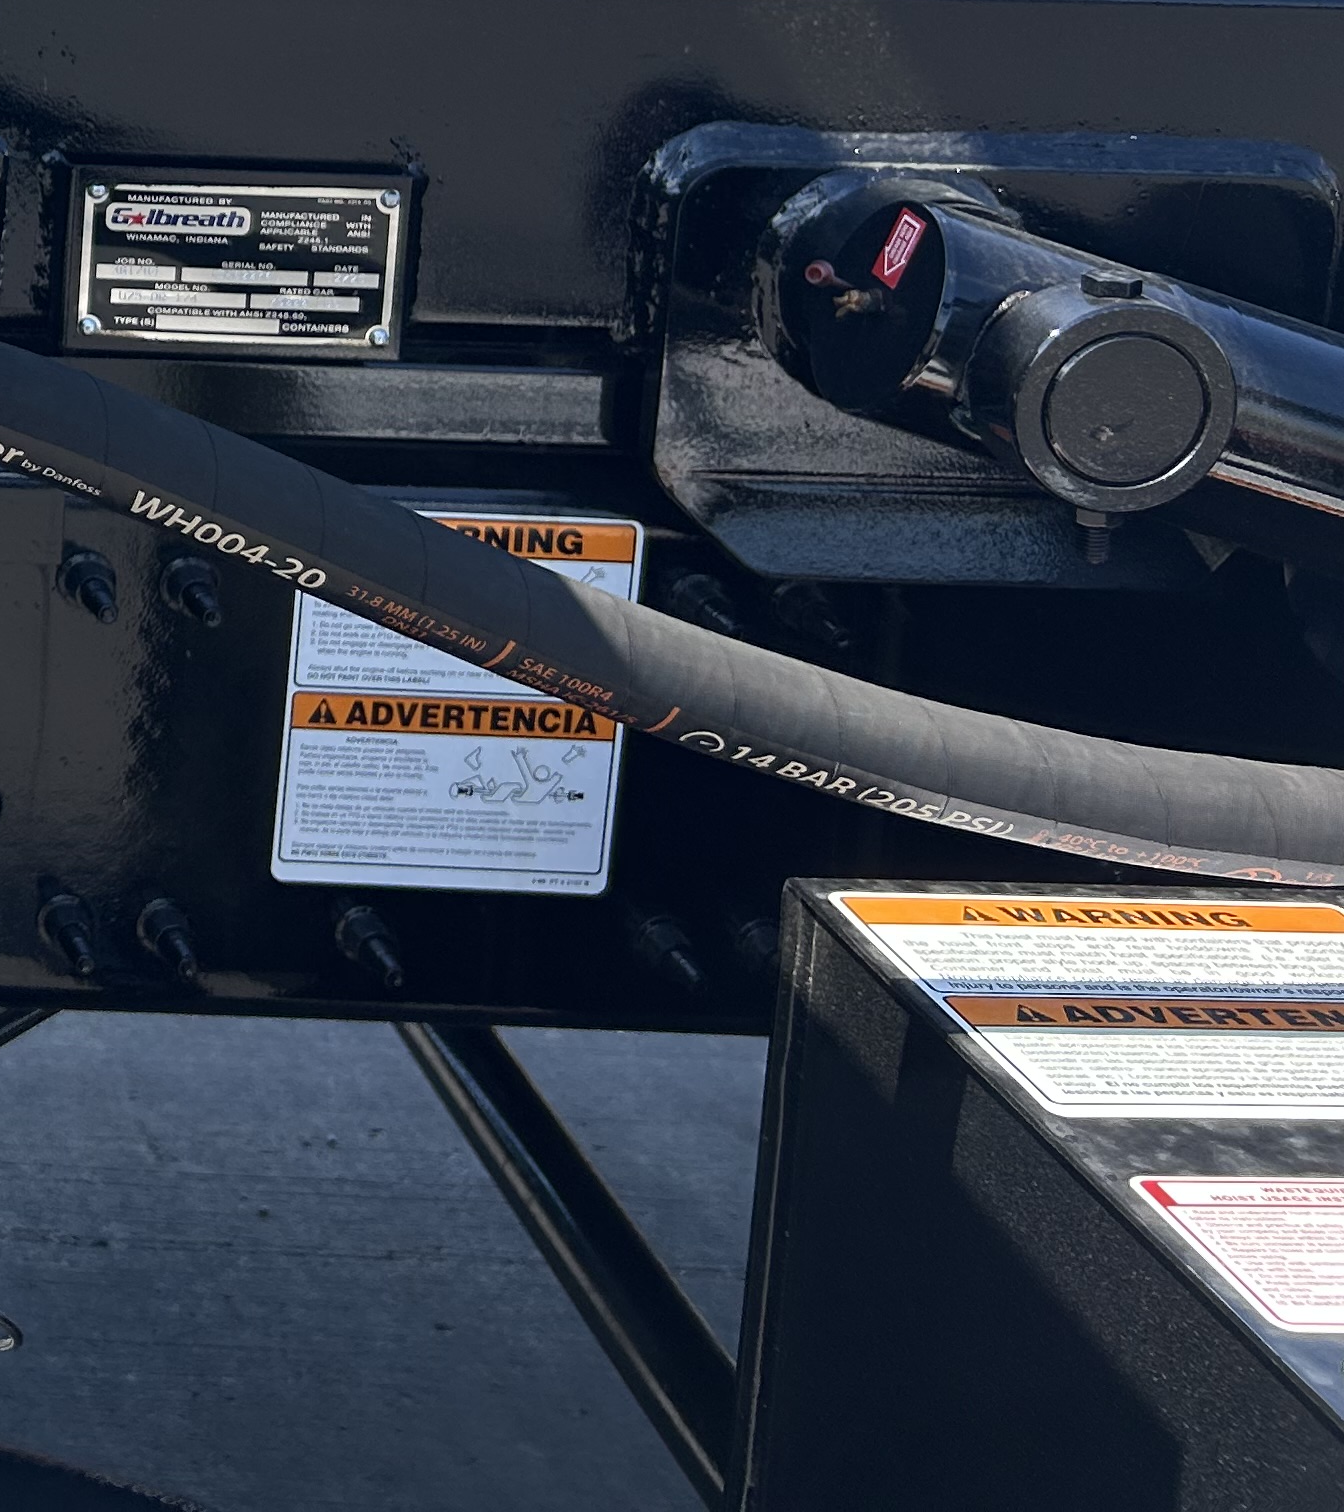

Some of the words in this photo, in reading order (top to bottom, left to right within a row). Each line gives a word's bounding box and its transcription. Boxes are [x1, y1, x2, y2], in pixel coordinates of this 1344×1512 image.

[128, 194, 213, 205] MANUFACTURED
[21, 459, 40, 472] by
[42, 467, 102, 497] Danfoss
[130, 490, 328, 589] WH004-20
[382, 600, 417, 623] MM
[519, 657, 553, 680] SAE
[345, 700, 597, 735] ADVERTENCIA
[776, 760, 857, 794] BAR
[996, 905, 1253, 927] WARNING
